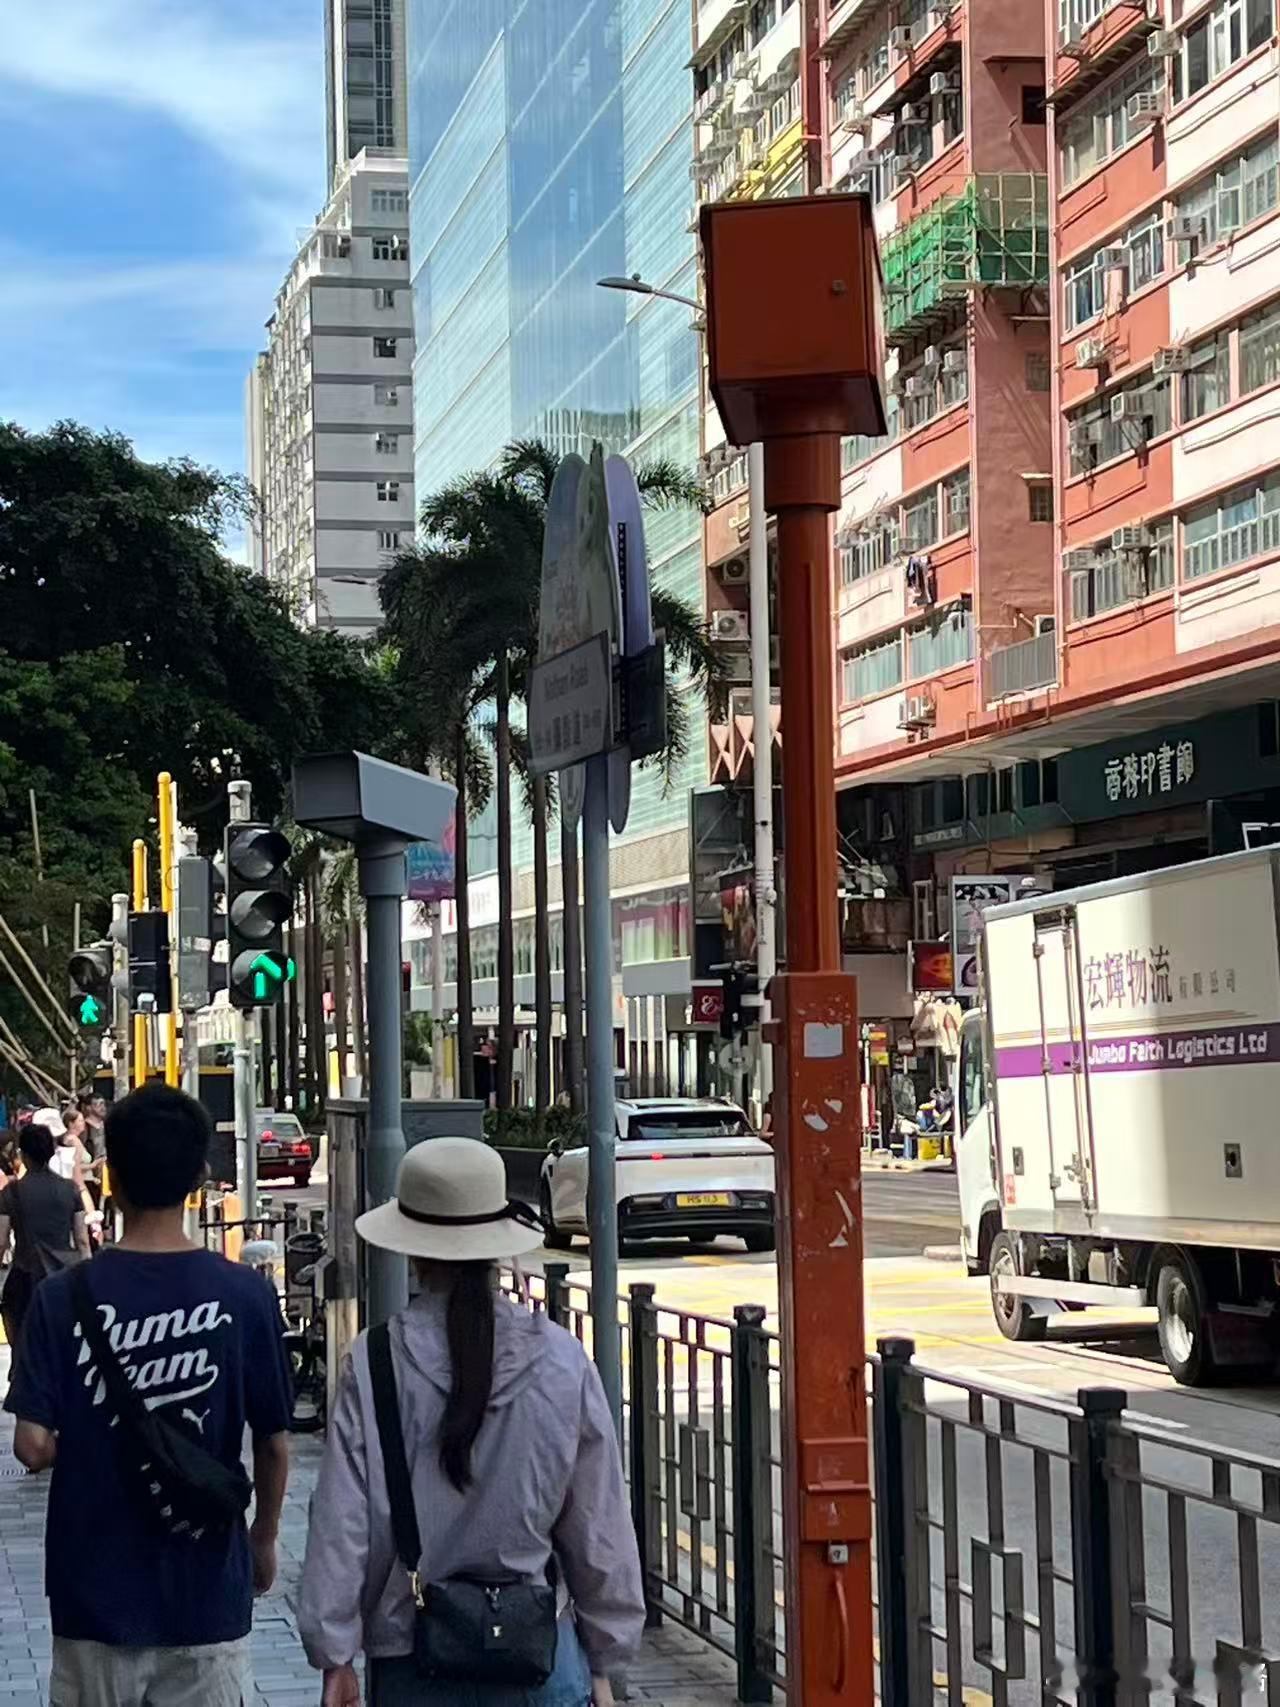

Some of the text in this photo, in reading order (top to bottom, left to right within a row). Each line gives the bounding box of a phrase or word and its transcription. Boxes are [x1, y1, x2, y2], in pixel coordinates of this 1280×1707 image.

[1104, 740, 1194, 801] 商務印書館
[1084, 944, 1173, 1010] 宏輝物流
[1088, 1031, 1267, 1066] Jumbo Faith Logistics Ltd
